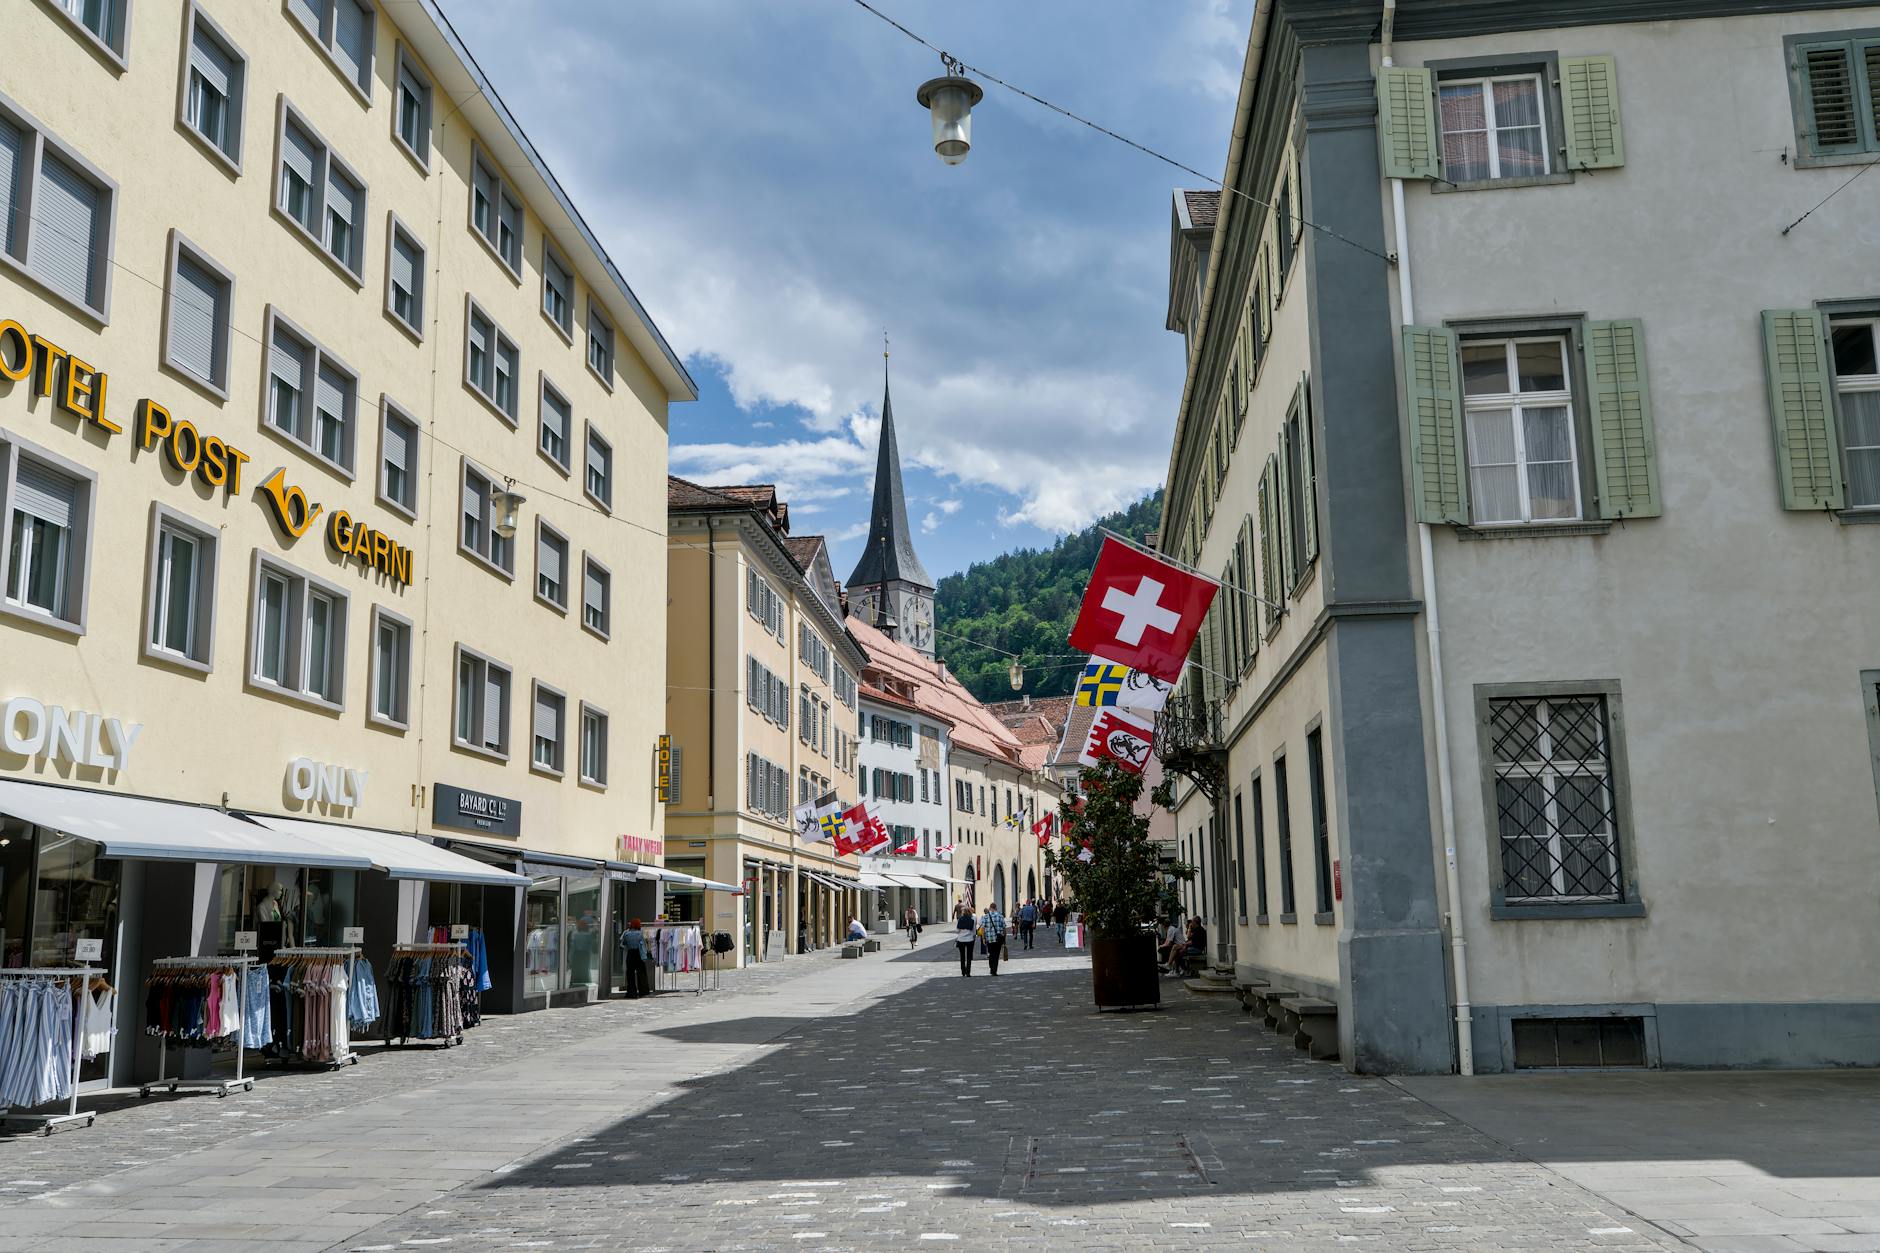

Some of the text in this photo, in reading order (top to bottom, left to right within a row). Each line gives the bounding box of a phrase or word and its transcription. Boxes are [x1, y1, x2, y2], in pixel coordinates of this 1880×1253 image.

[138, 397, 250, 496] POST
[329, 510, 413, 586] GARNI
[1, 696, 144, 771] ONLY
[289, 757, 368, 808] ONLY
[659, 736, 670, 801] HOTEL
[460, 793, 487, 812] BAYARD
[623, 834, 642, 852] TALLY
